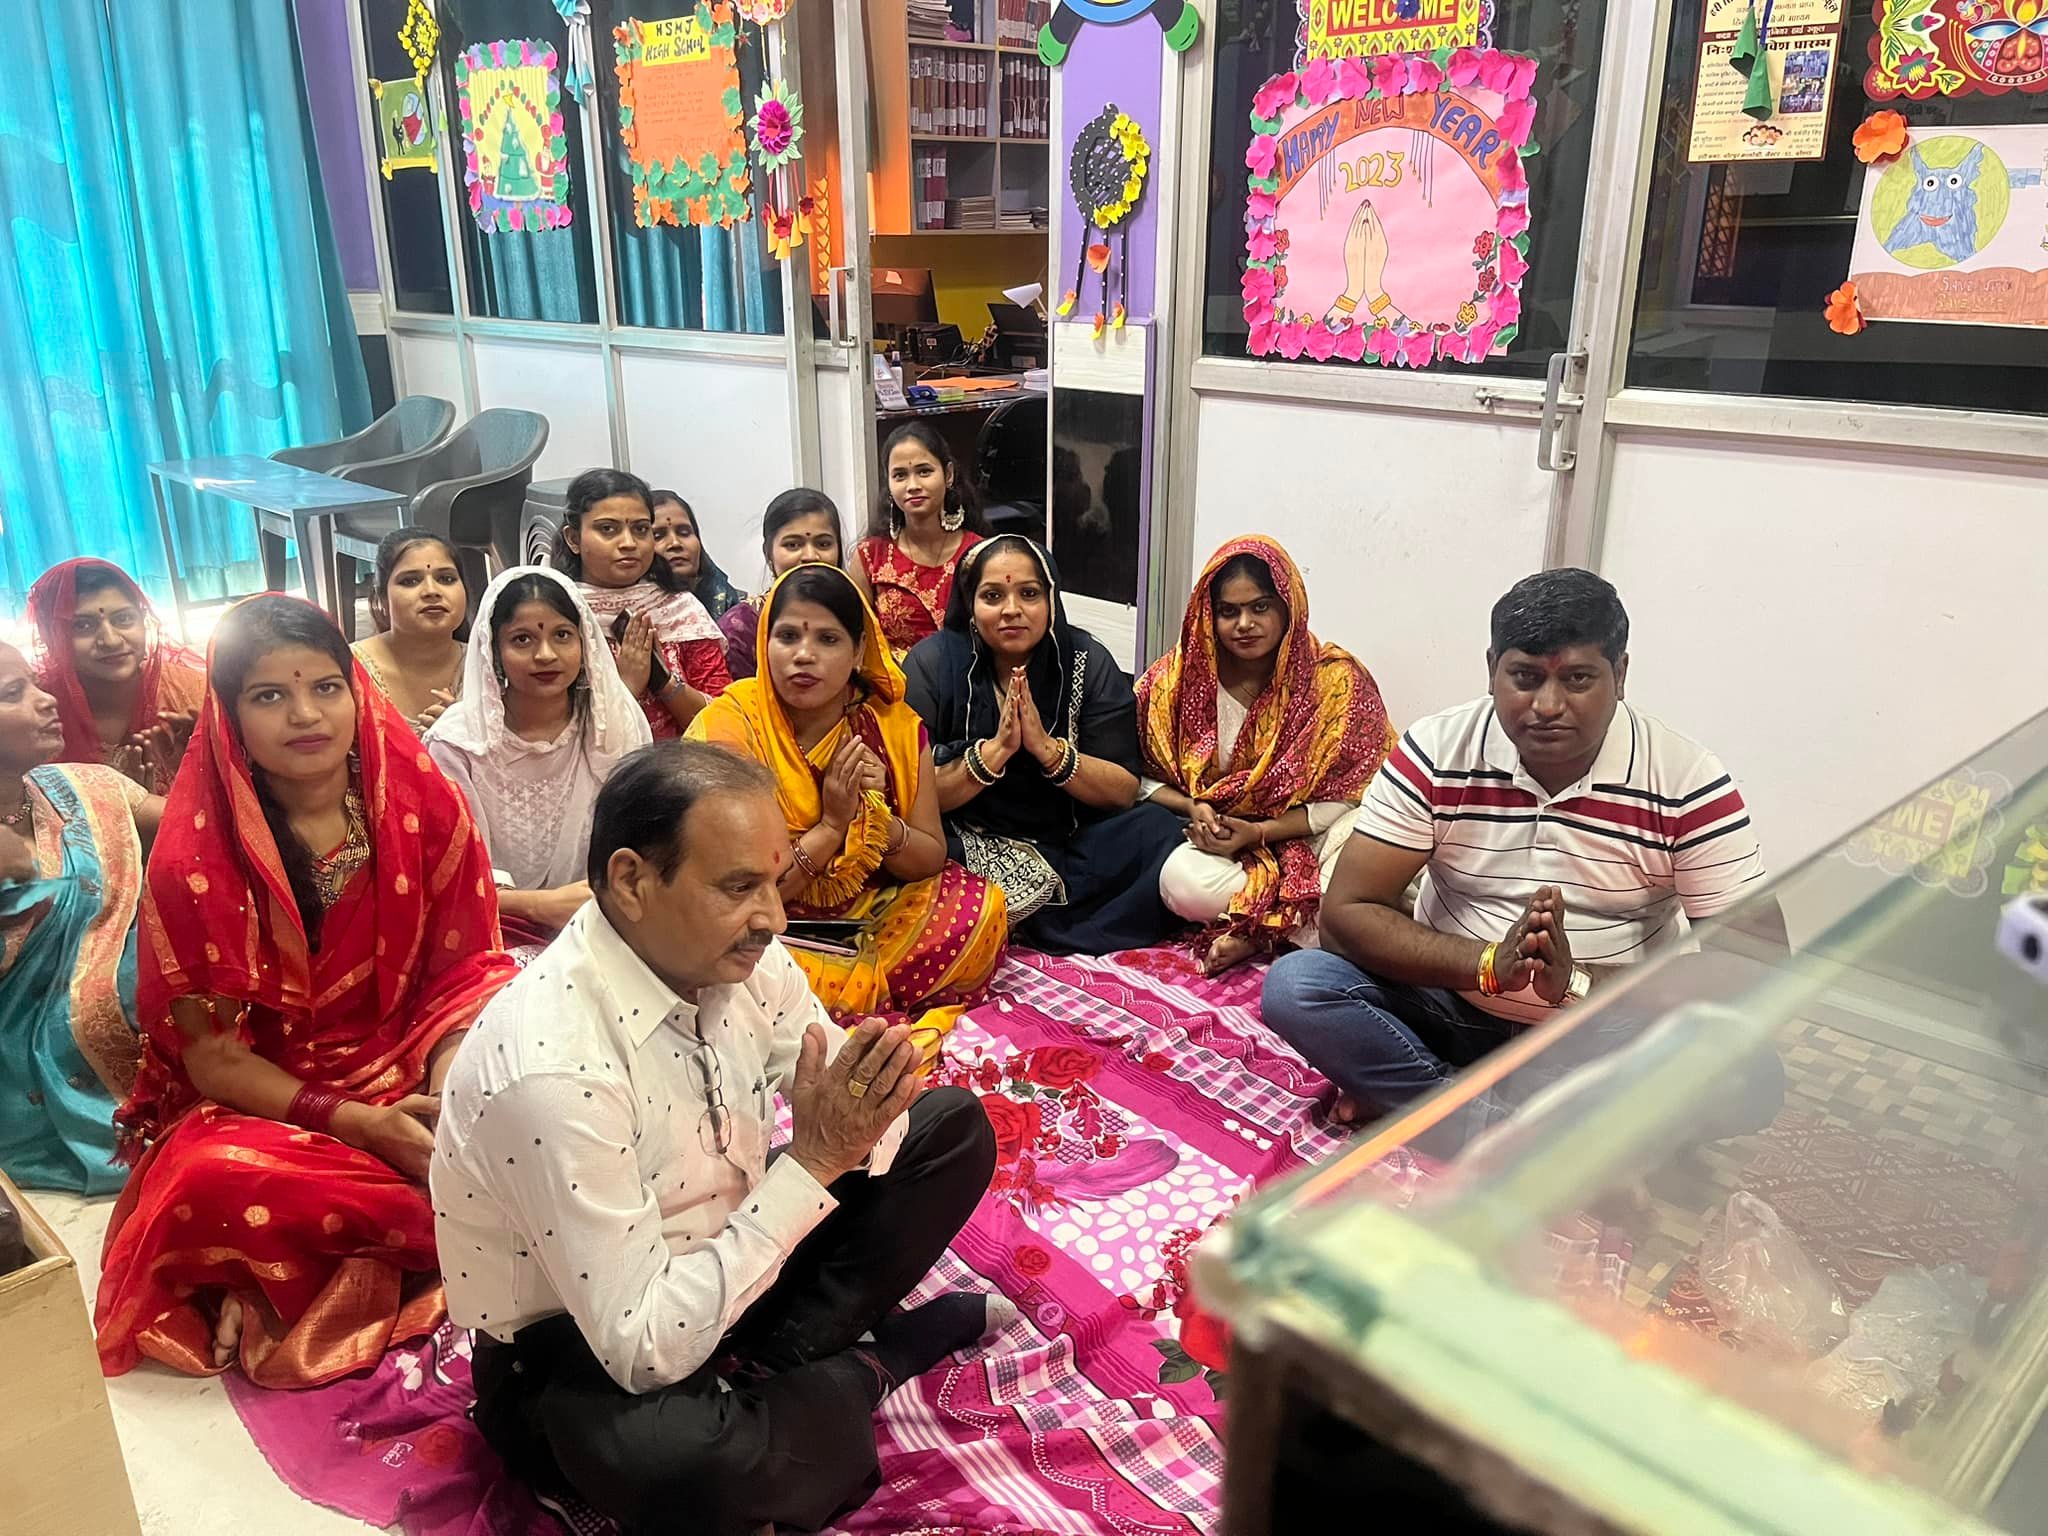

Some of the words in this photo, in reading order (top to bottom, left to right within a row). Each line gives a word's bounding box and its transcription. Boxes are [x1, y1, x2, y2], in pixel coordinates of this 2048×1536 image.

[1331, 0, 1455, 30] WELCME
[1282, 112, 1340, 182] HAPPY
[1355, 93, 1405, 129] NEW
[1430, 93, 1501, 170] YEAR
[1338, 150, 1405, 193] 2023
